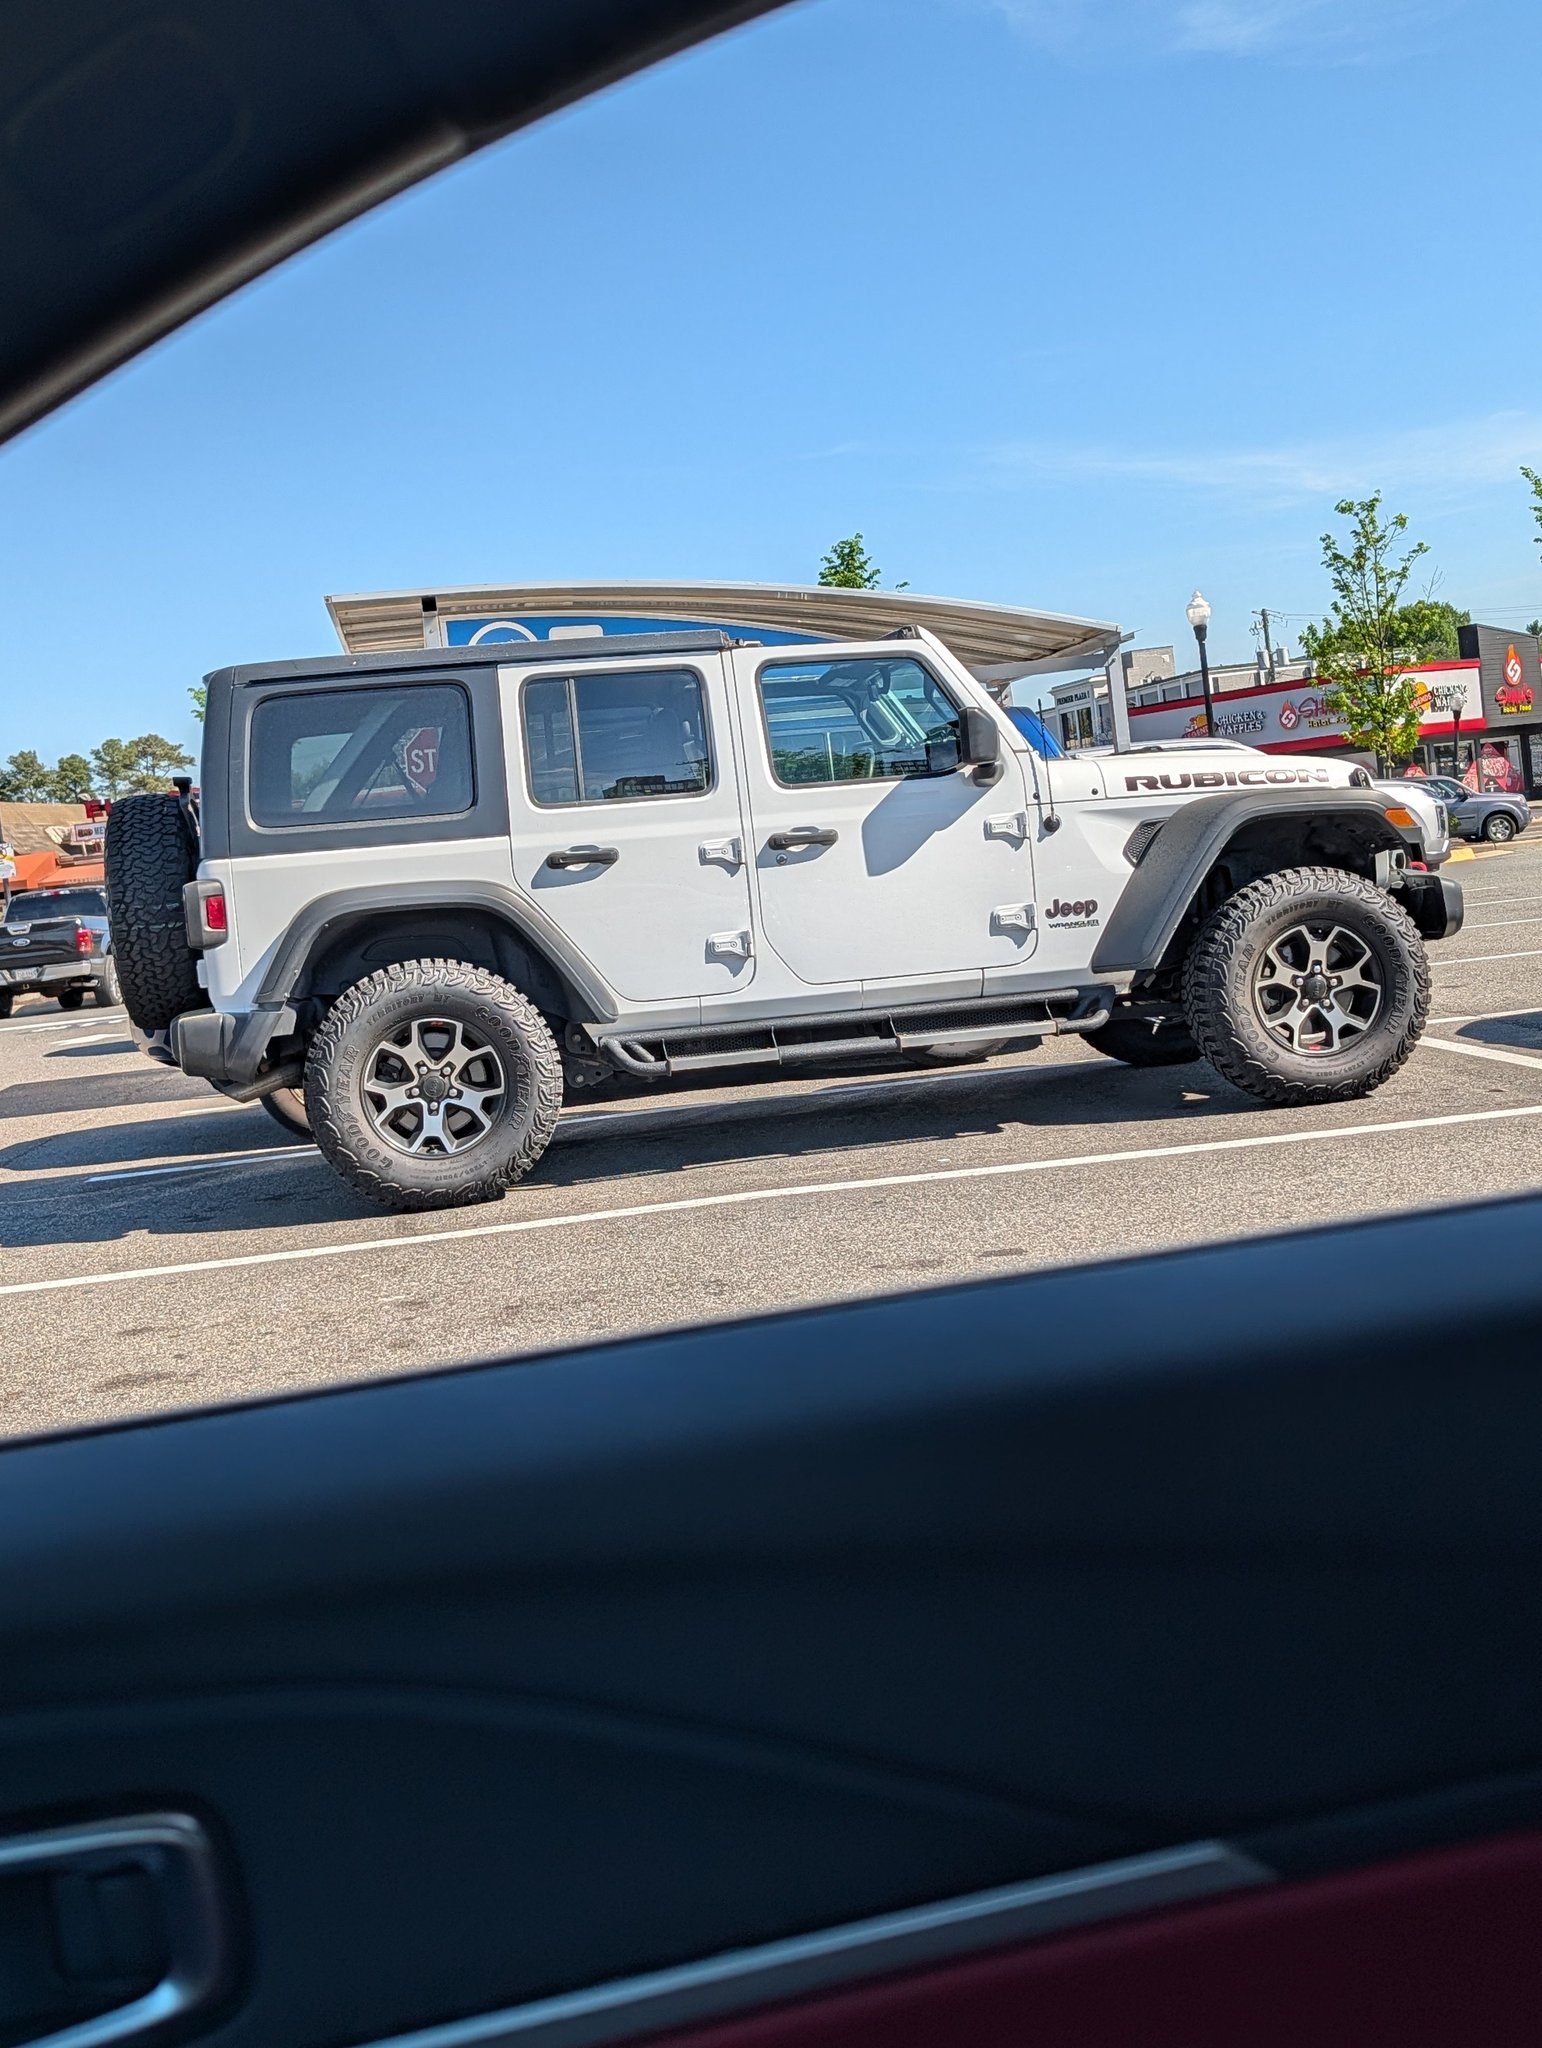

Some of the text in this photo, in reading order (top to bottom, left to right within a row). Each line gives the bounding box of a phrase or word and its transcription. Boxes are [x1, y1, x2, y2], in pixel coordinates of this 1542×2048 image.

[1432, 684, 1463, 696] CHICKEN
[1216, 711, 1265, 725] CHICKEN &
[1218, 721, 1262, 736] WAFFLES
[411, 748, 437, 773] ST
[1124, 769, 1329, 791] RUBICON
[1045, 898, 1098, 919] Jeep
[335, 1045, 394, 1170] GOODYEAR
